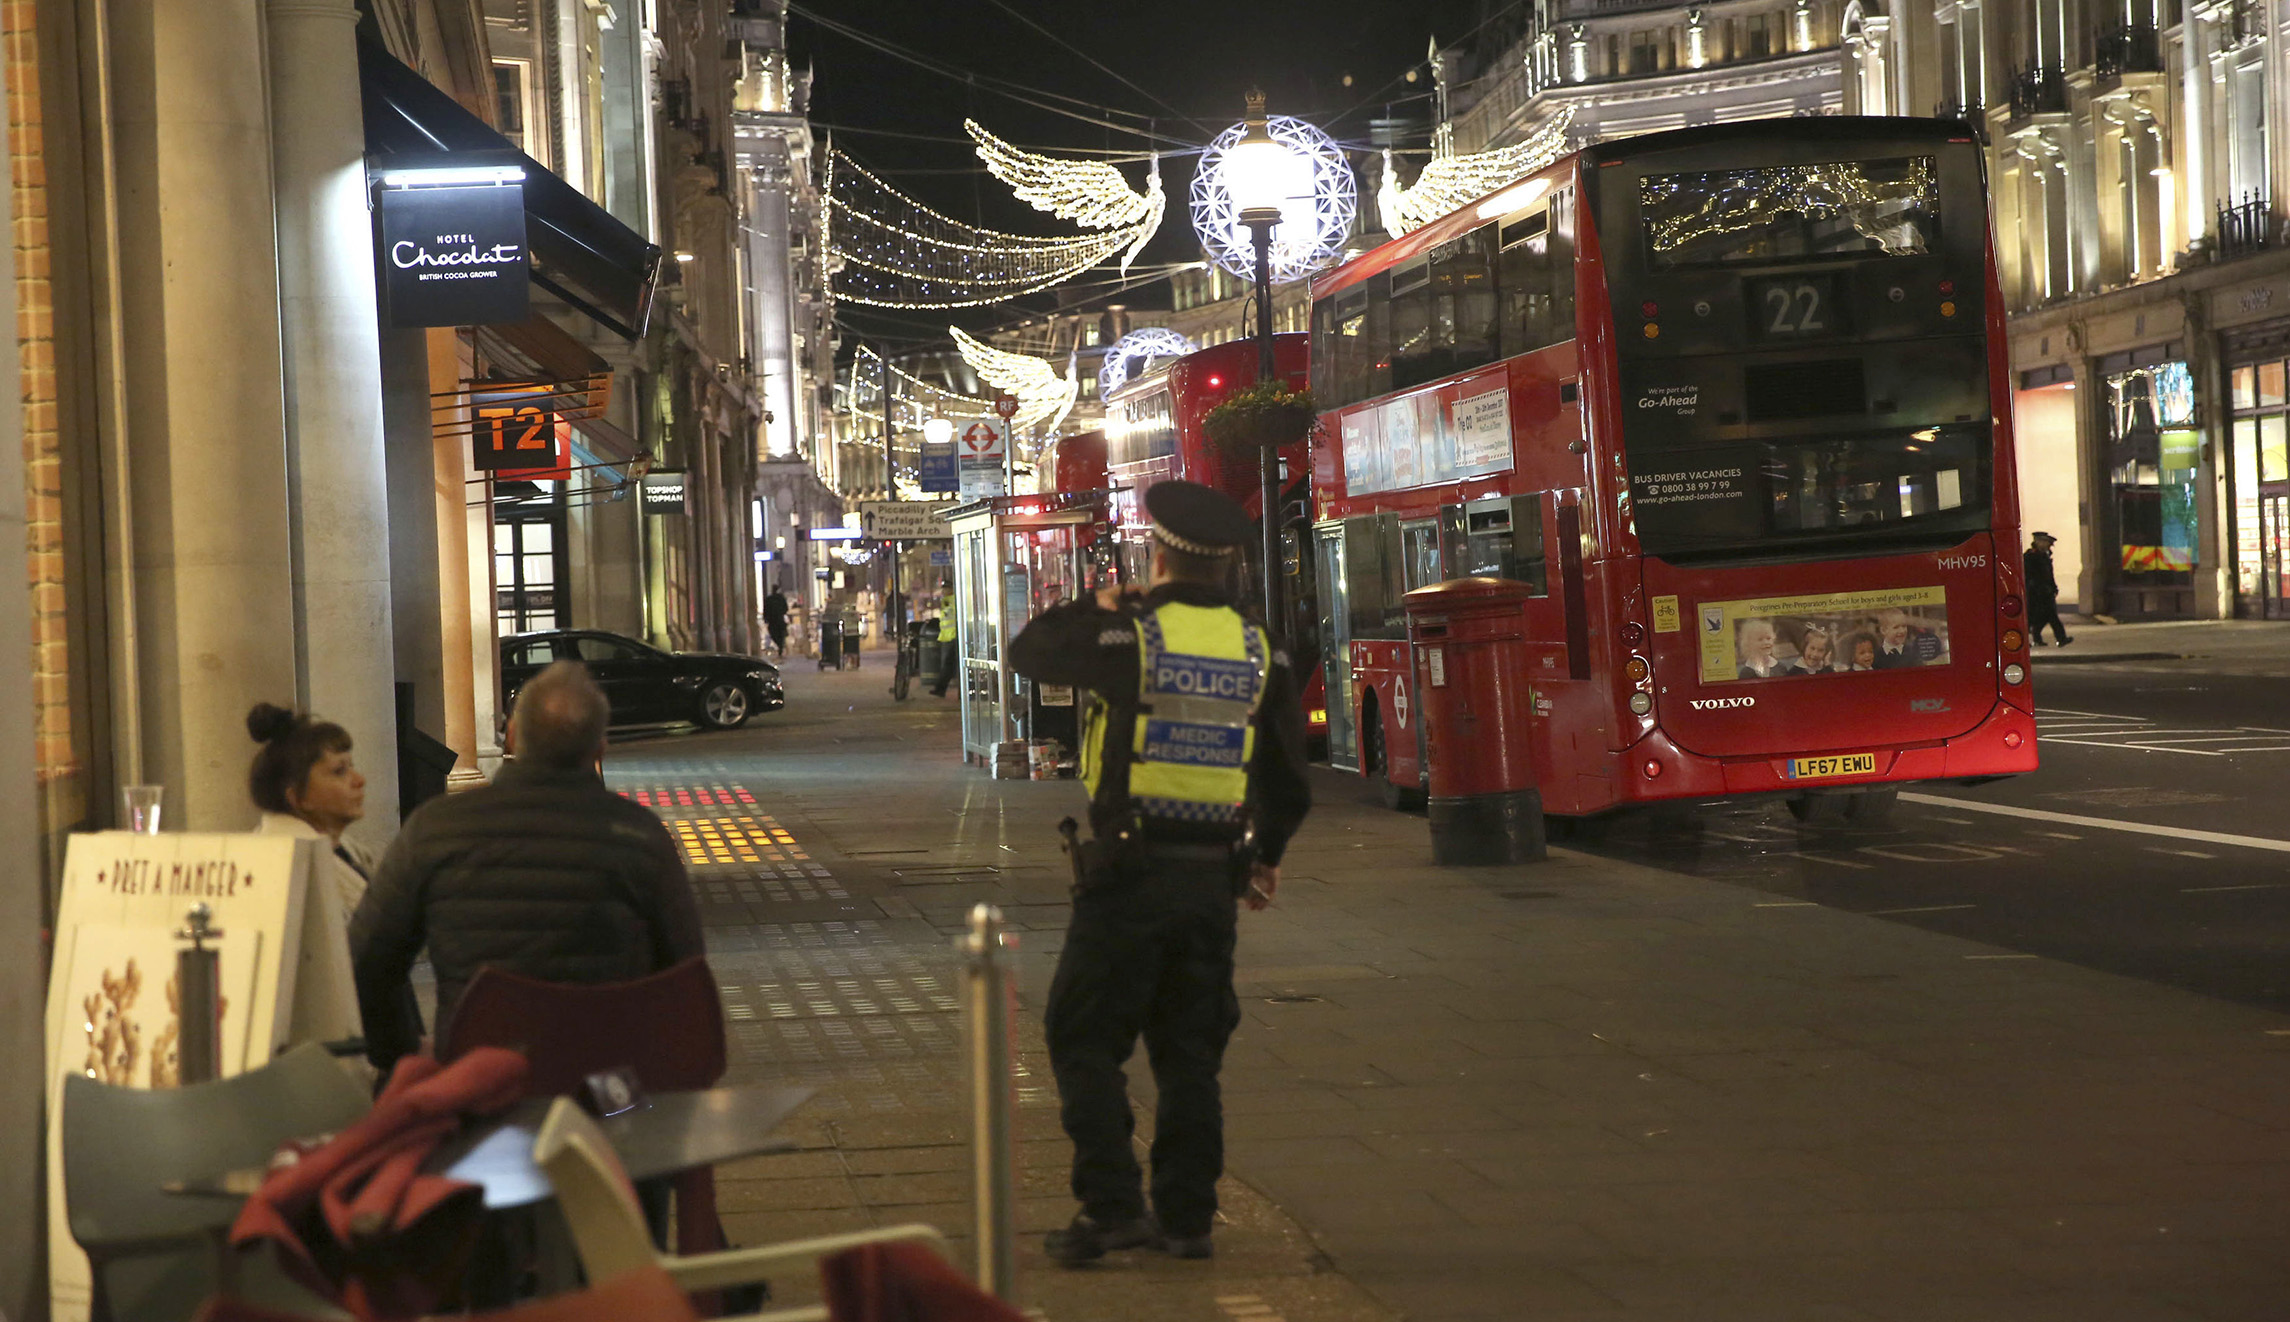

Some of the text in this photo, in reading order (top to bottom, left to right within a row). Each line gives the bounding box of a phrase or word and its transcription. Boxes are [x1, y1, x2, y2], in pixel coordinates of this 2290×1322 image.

[436, 234, 474, 244] HOTEL
[391, 240, 521, 269] Chocolat.
[419, 270, 498, 281] BRITISH COCOA GROWER
[1767, 285, 1823, 333] 22
[1666, 387, 1679, 395] part
[1680, 385, 1688, 394] of
[1000, 401, 1014, 412] RF
[1638, 394, 1698, 409] Go-Ahead
[1677, 408, 1696, 416] Group
[479, 406, 546, 451] T2
[1634, 468, 1742, 484] BUS DRIVER VACANCIES
[646, 485, 683, 494] TOPSHOP
[1662, 480, 1730, 493] 0800 38 99 7 99
[646, 494, 684, 503] TOPMAN
[1637, 490, 1743, 505] www.go-ahead-london.com
[878, 504, 926, 515] Piccadilly
[879, 516, 924, 526] Trafalgar
[879, 526, 940, 535] Marble Arch
[1937, 554, 1986, 570] MHV95
[1829, 597, 1850, 605] School
[1860, 596, 1875, 604] boys
[1888, 594, 1901, 604] girls
[1903, 592, 1917, 601] aged
[1158, 667, 1250, 699] POLICE
[1689, 696, 1755, 710] VOLVO
[1169, 726, 1228, 745] MEDIC
[1147, 741, 1240, 761] RESPONSE
[1798, 755, 1873, 776] LF67 EWU
[112, 859, 238, 896] PRET A MANGER
